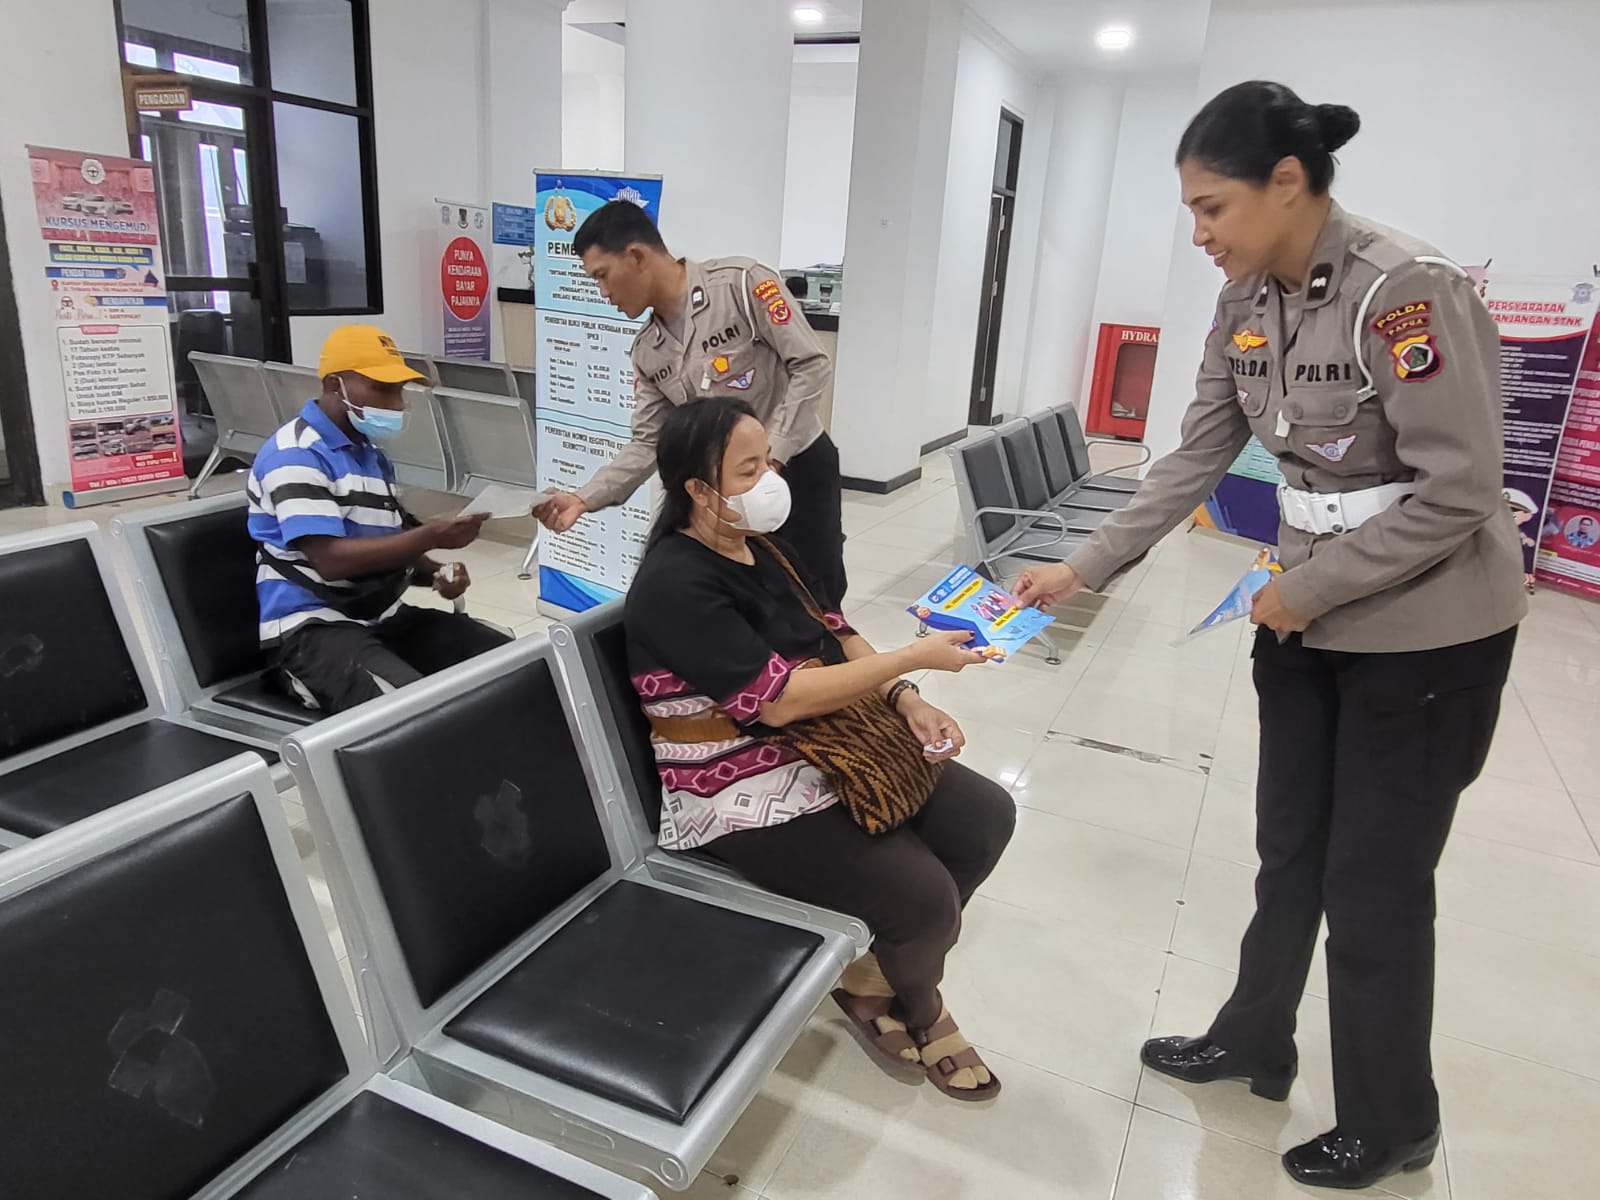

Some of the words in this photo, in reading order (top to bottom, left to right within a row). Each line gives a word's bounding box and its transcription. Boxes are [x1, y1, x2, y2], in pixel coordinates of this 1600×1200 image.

[138, 93, 186, 105] PENGADUAN
[45, 216, 88, 228] KURSUS
[90, 218, 150, 231] MENGEMUDI
[454, 249, 474, 262] PUNYA
[448, 264, 482, 277] KENDARAAN
[456, 280, 475, 291] BAYAR
[451, 295, 481, 306] PAJAKNYA
[1487, 300, 1566, 313] PERSYARATAN
[1376, 303, 1426, 329] POLDA
[1551, 317, 1583, 327] STNK
[1388, 318, 1423, 336] PAPUA
[701, 324, 741, 354] POLRI
[1121, 330, 1157, 342] HYDRA
[1294, 363, 1352, 382] POLRI
